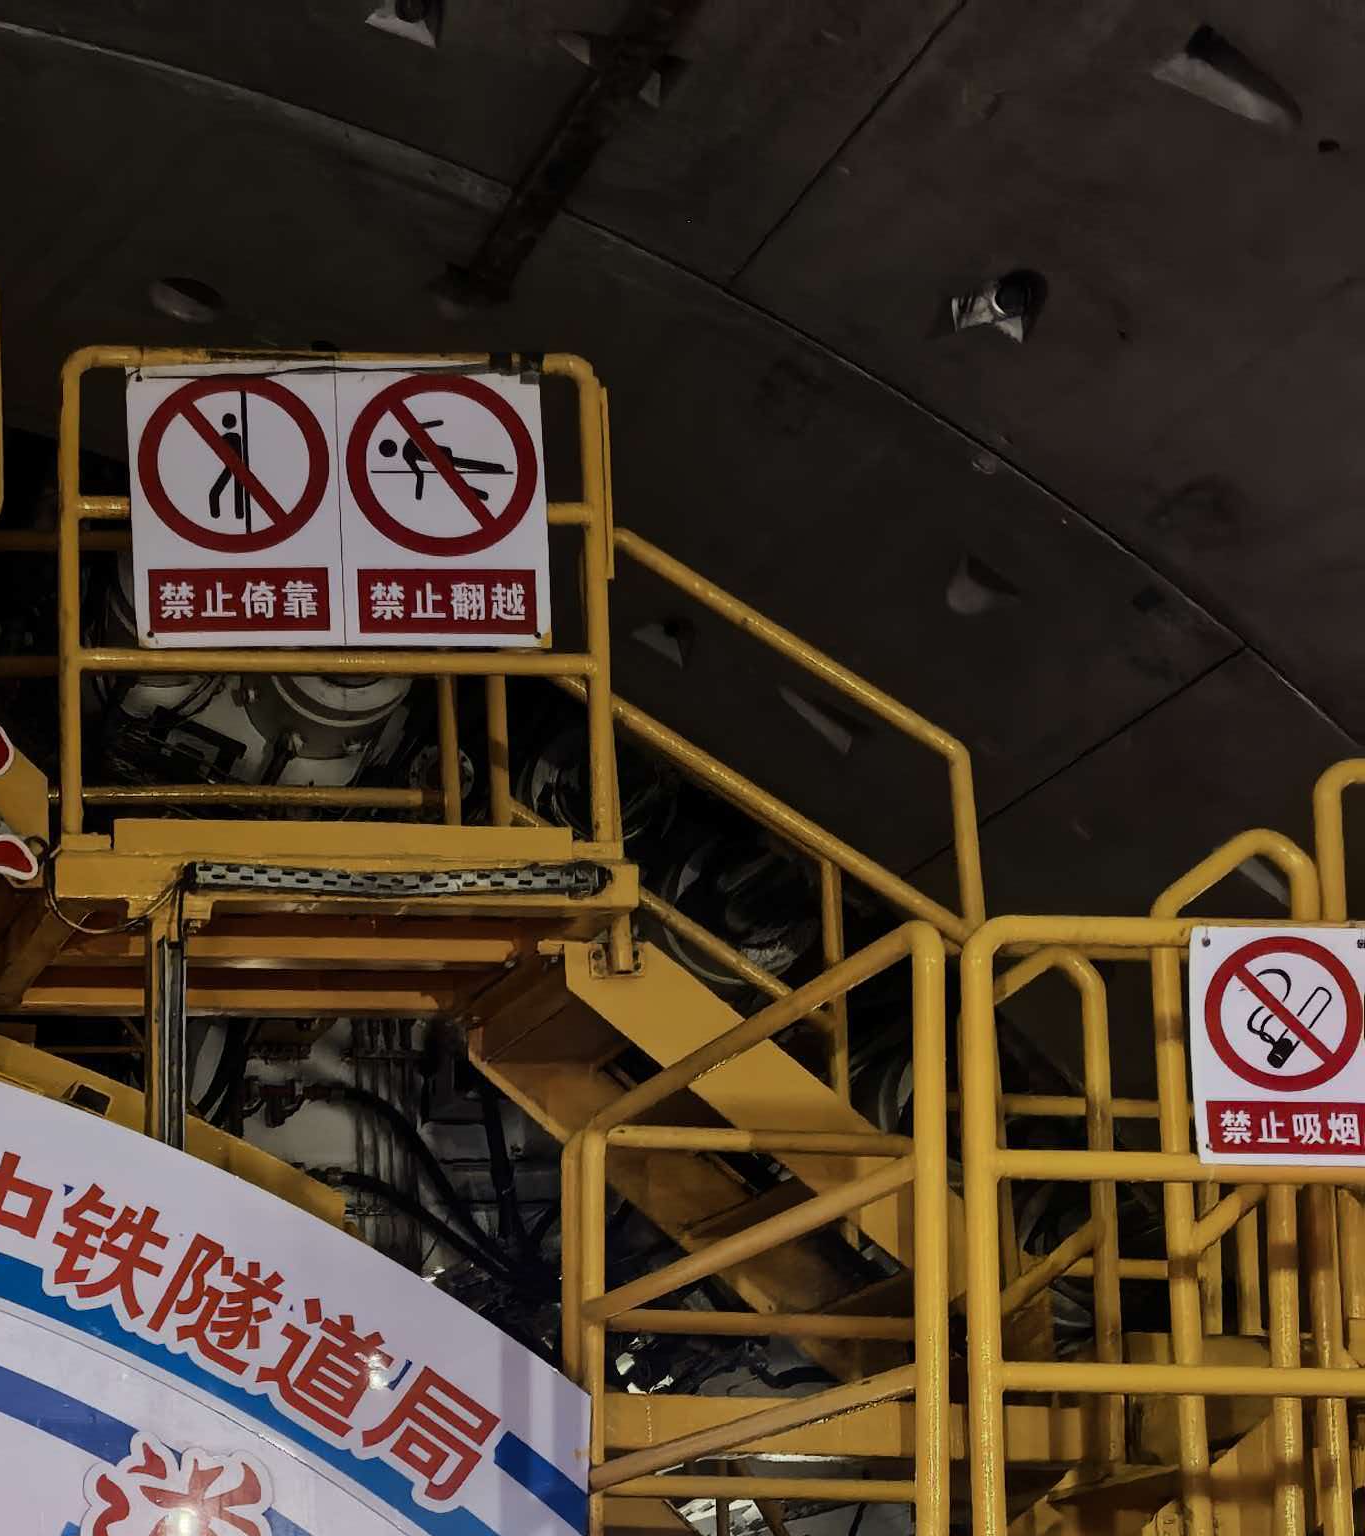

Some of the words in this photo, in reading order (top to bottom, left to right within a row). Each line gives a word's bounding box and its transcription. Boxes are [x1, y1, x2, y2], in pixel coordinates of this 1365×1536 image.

[159, 580, 319, 621] 禁止倚靠
[369, 582, 526, 621] 禁止翻越
[1220, 1110, 1361, 1145] 禁止吸烟
